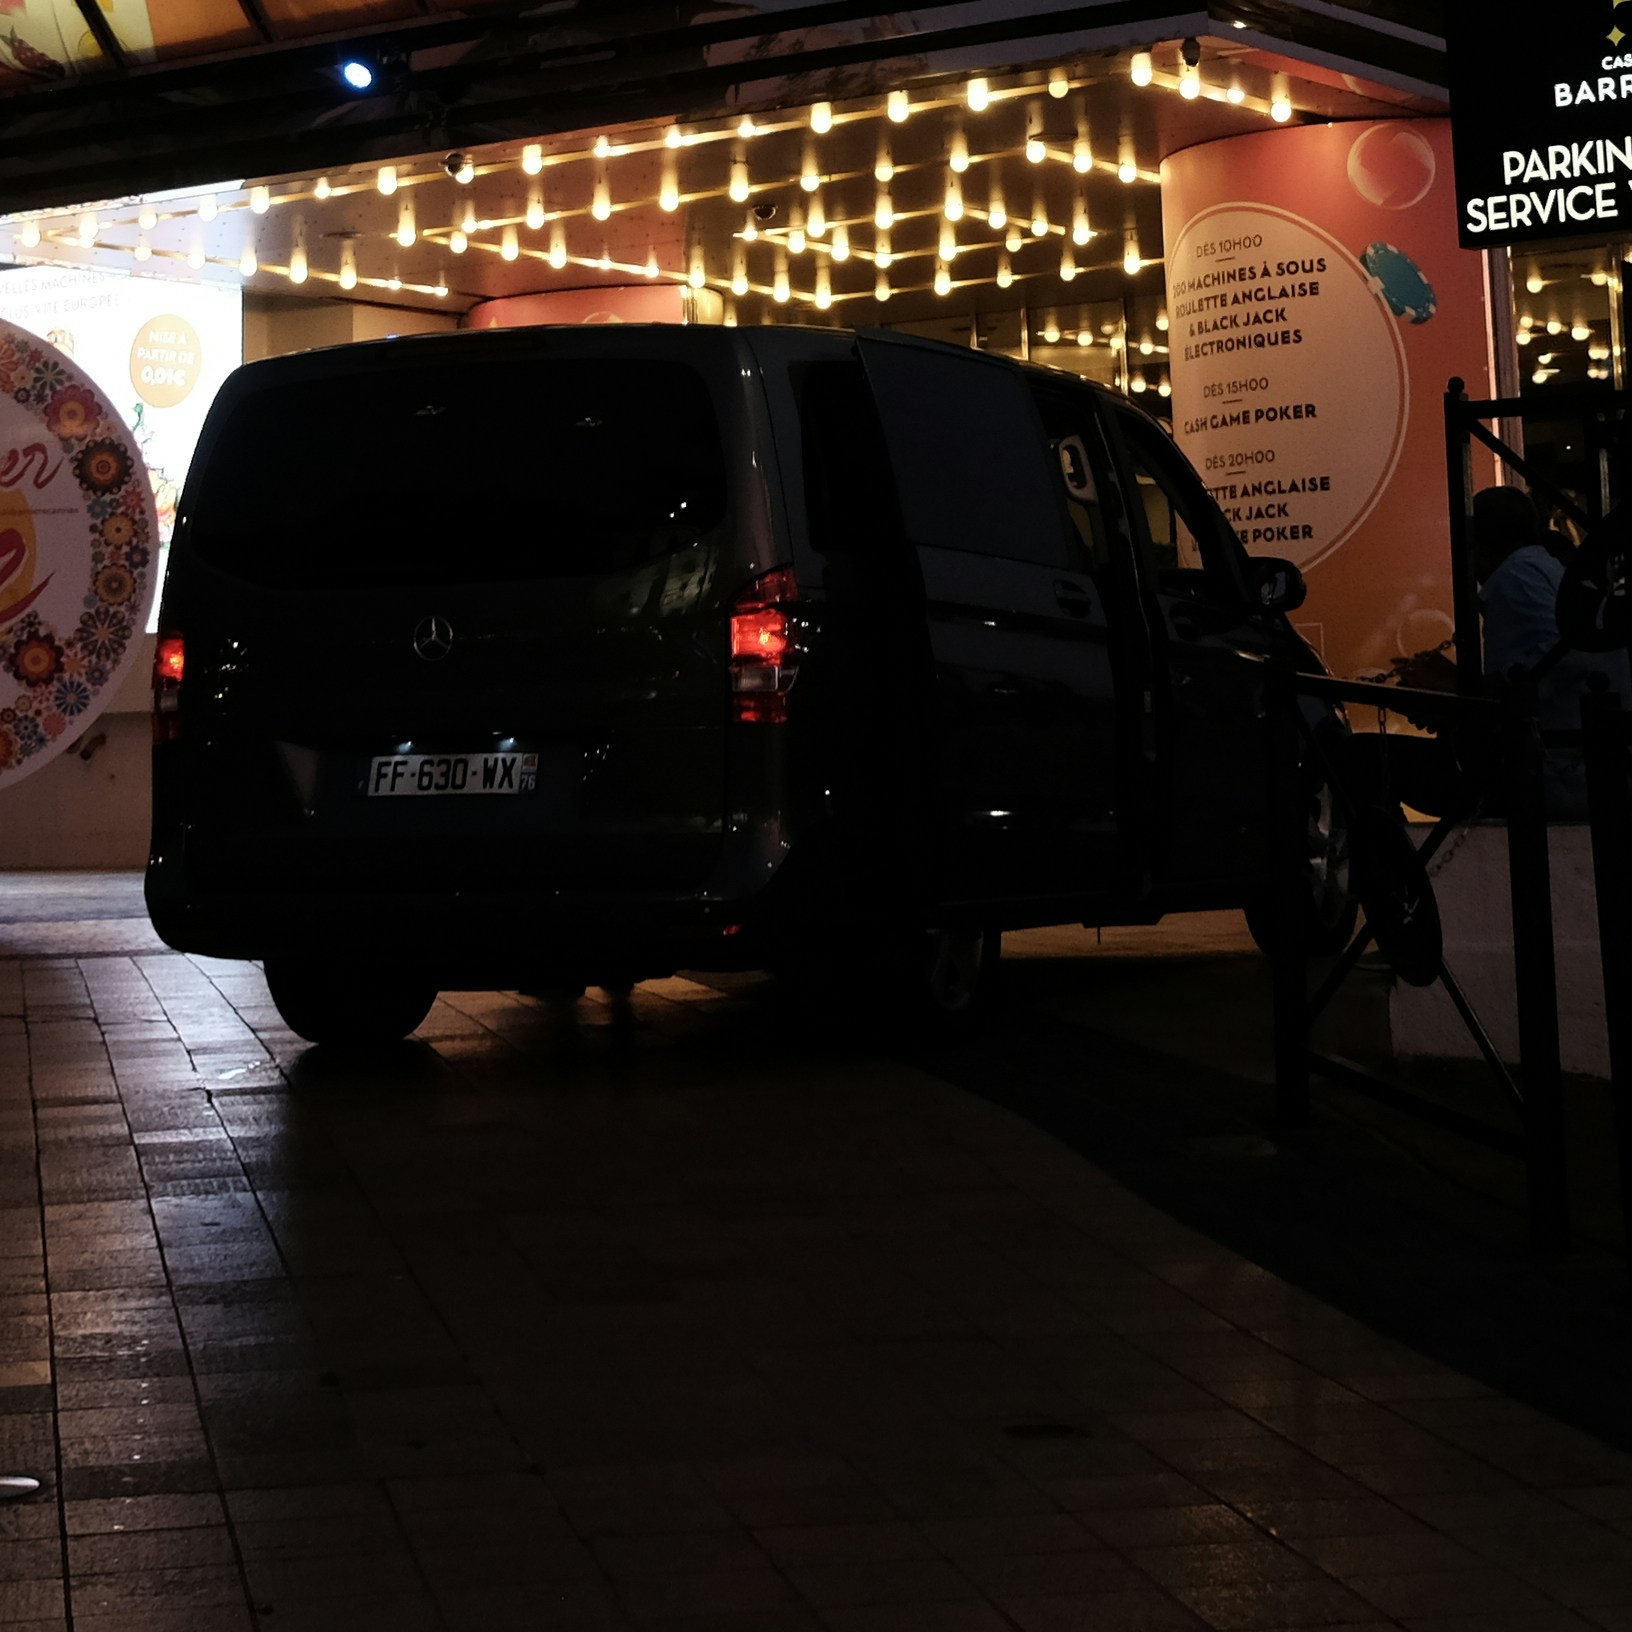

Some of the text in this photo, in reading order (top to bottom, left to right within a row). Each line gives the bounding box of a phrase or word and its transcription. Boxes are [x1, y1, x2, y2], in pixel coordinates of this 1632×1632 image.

[1466, 181, 1619, 235] SERVICE
[1219, 233, 1263, 254] 10H00
[1188, 266, 1257, 293] MACHINES
[1276, 257, 1328, 277] SOUS
[1175, 281, 1320, 320] ROULETTE ANGLAISE
[1197, 312, 1240, 336] BLACK
[1243, 307, 1288, 327] JACK
[149, 330, 177, 345] MISE
[137, 347, 195, 365] PARTIR DE
[1226, 376, 1269, 395] 15H00
[1184, 402, 1318, 435] CASH GAME POKER
[1228, 448, 1276, 468] 20H00
[1240, 476, 1330, 498] ANGLAISE
[1245, 502, 1289, 522] JACK
[1252, 524, 1314, 545] POKER
[521, 774, 536, 791] 76
